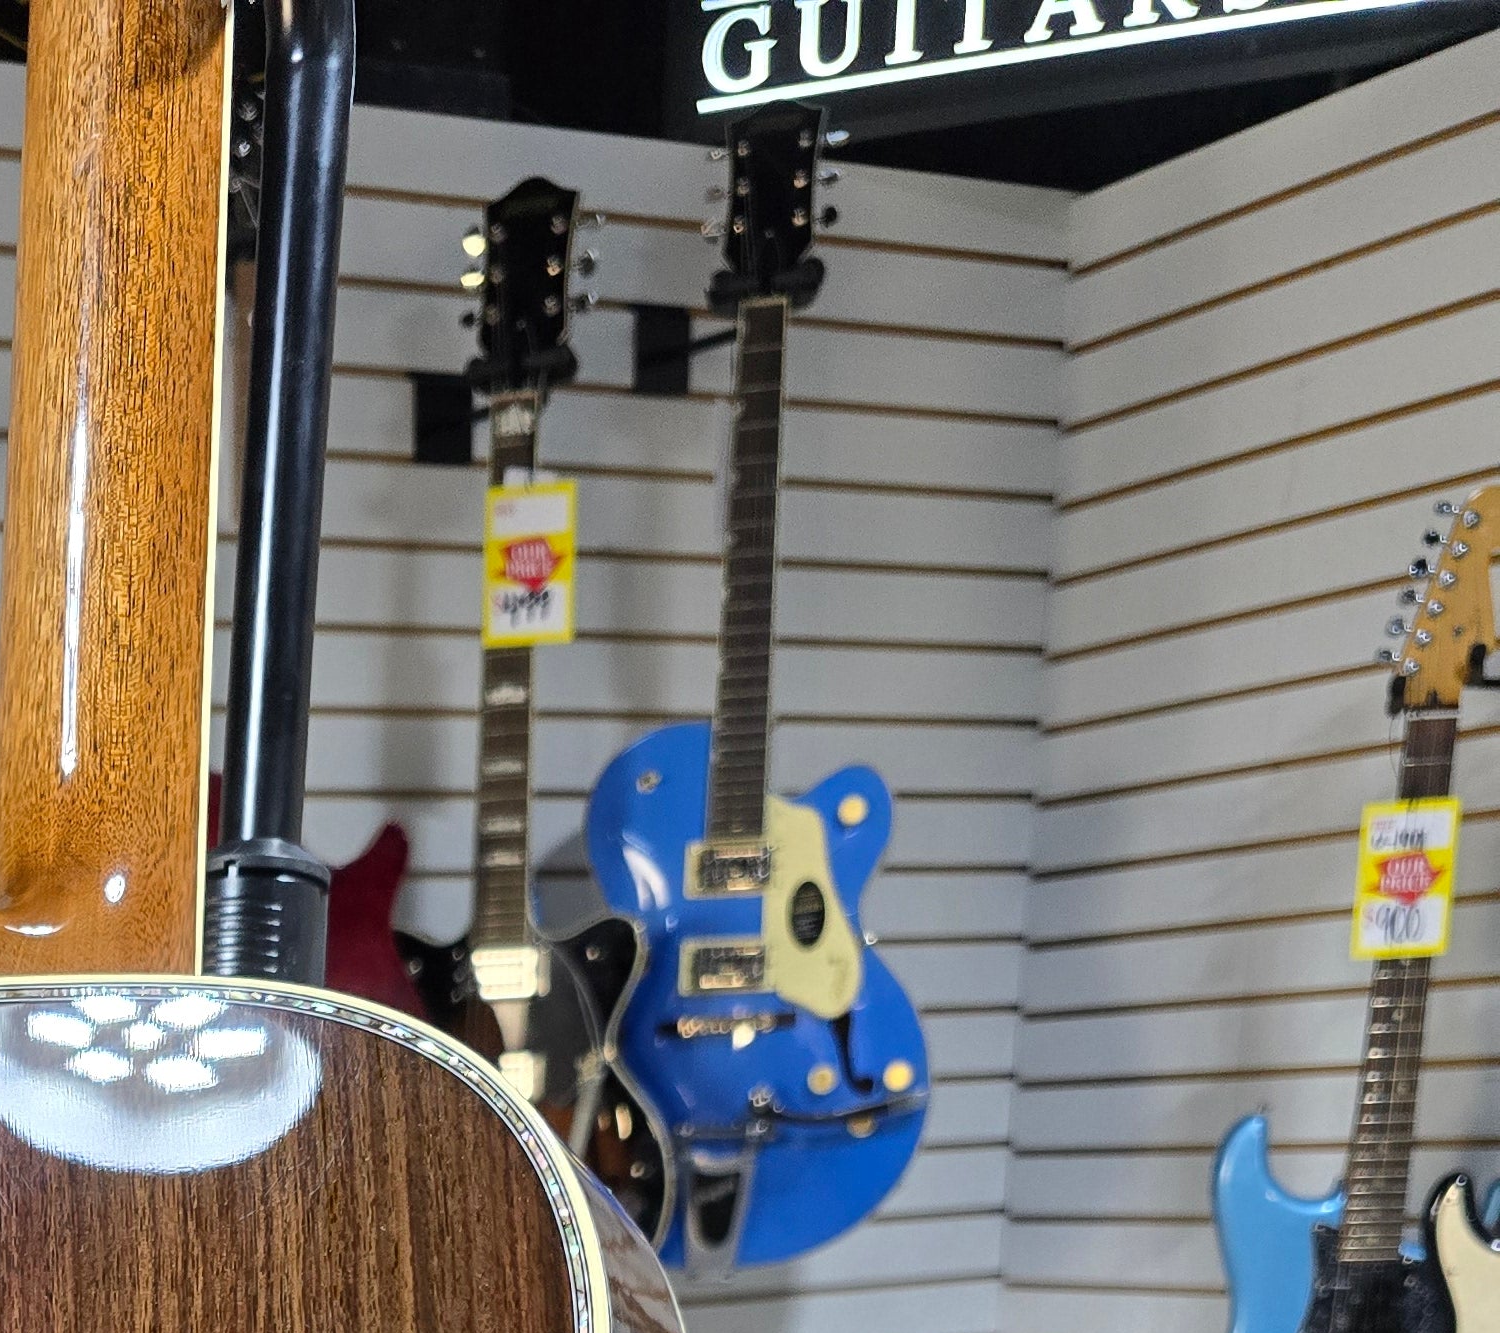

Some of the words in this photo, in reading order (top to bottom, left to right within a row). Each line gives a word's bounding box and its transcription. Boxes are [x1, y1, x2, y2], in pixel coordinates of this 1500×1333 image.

[702, 0, 1268, 93] GUITA
[1386, 857, 1427, 877] OUR
[1379, 872, 1434, 893] PRICE
